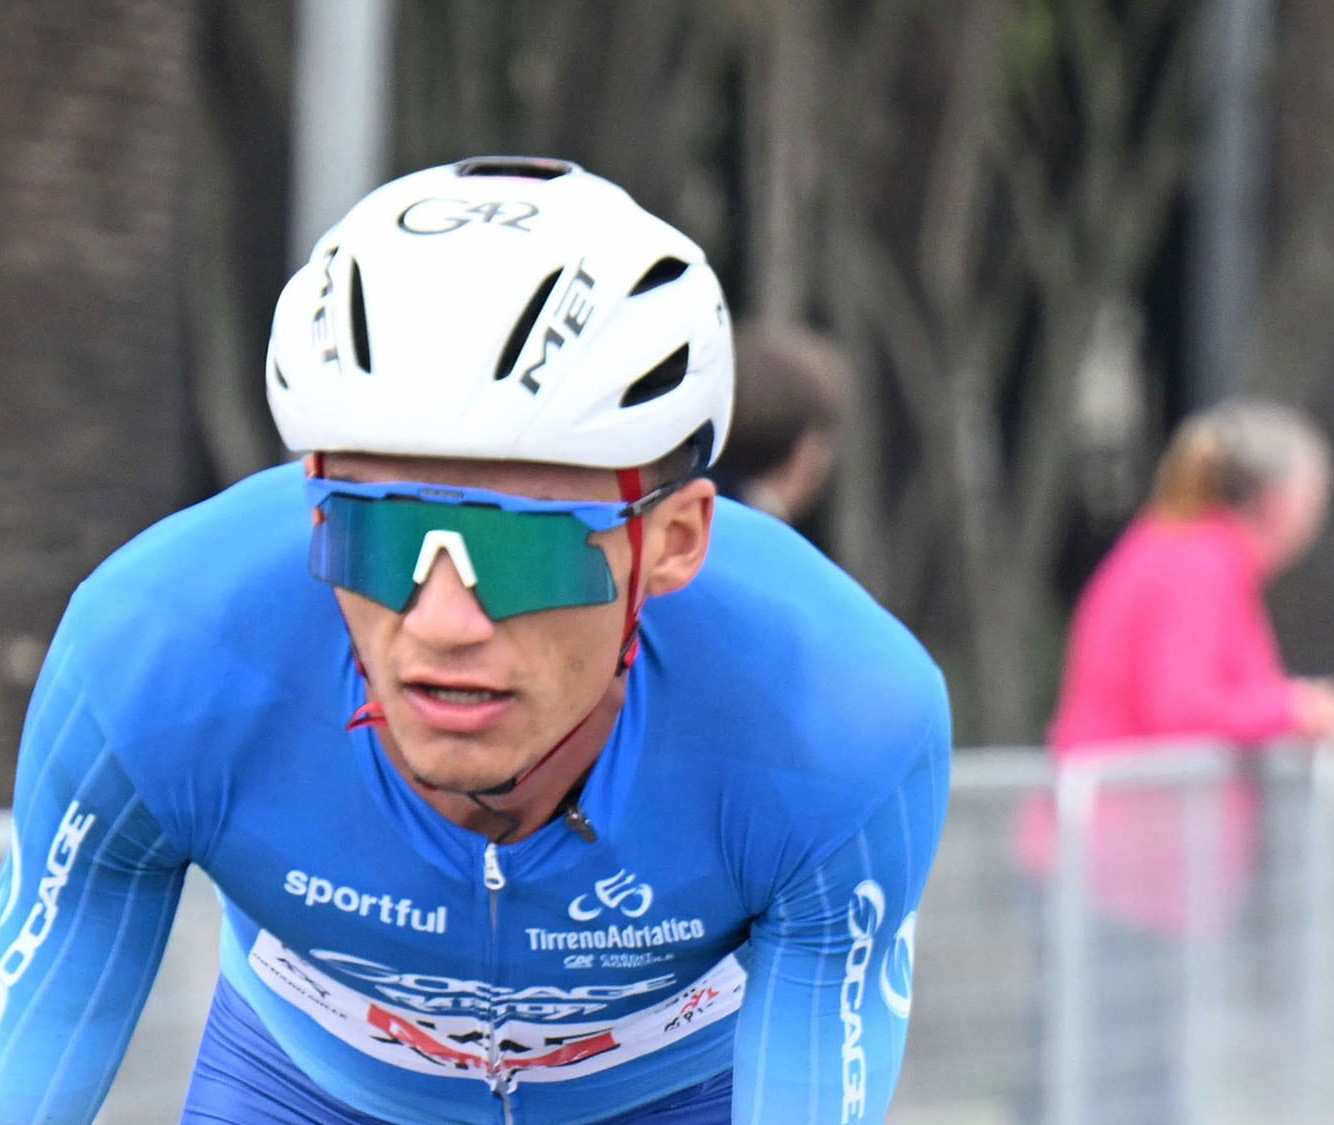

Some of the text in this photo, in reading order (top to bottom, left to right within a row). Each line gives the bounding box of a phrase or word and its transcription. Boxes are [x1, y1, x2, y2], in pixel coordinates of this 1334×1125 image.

[396, 197, 541, 236] G42
[518, 255, 598, 397] MET
[283, 869, 447, 934] sportful
[525, 917, 706, 951] TirrenoAdriatico
